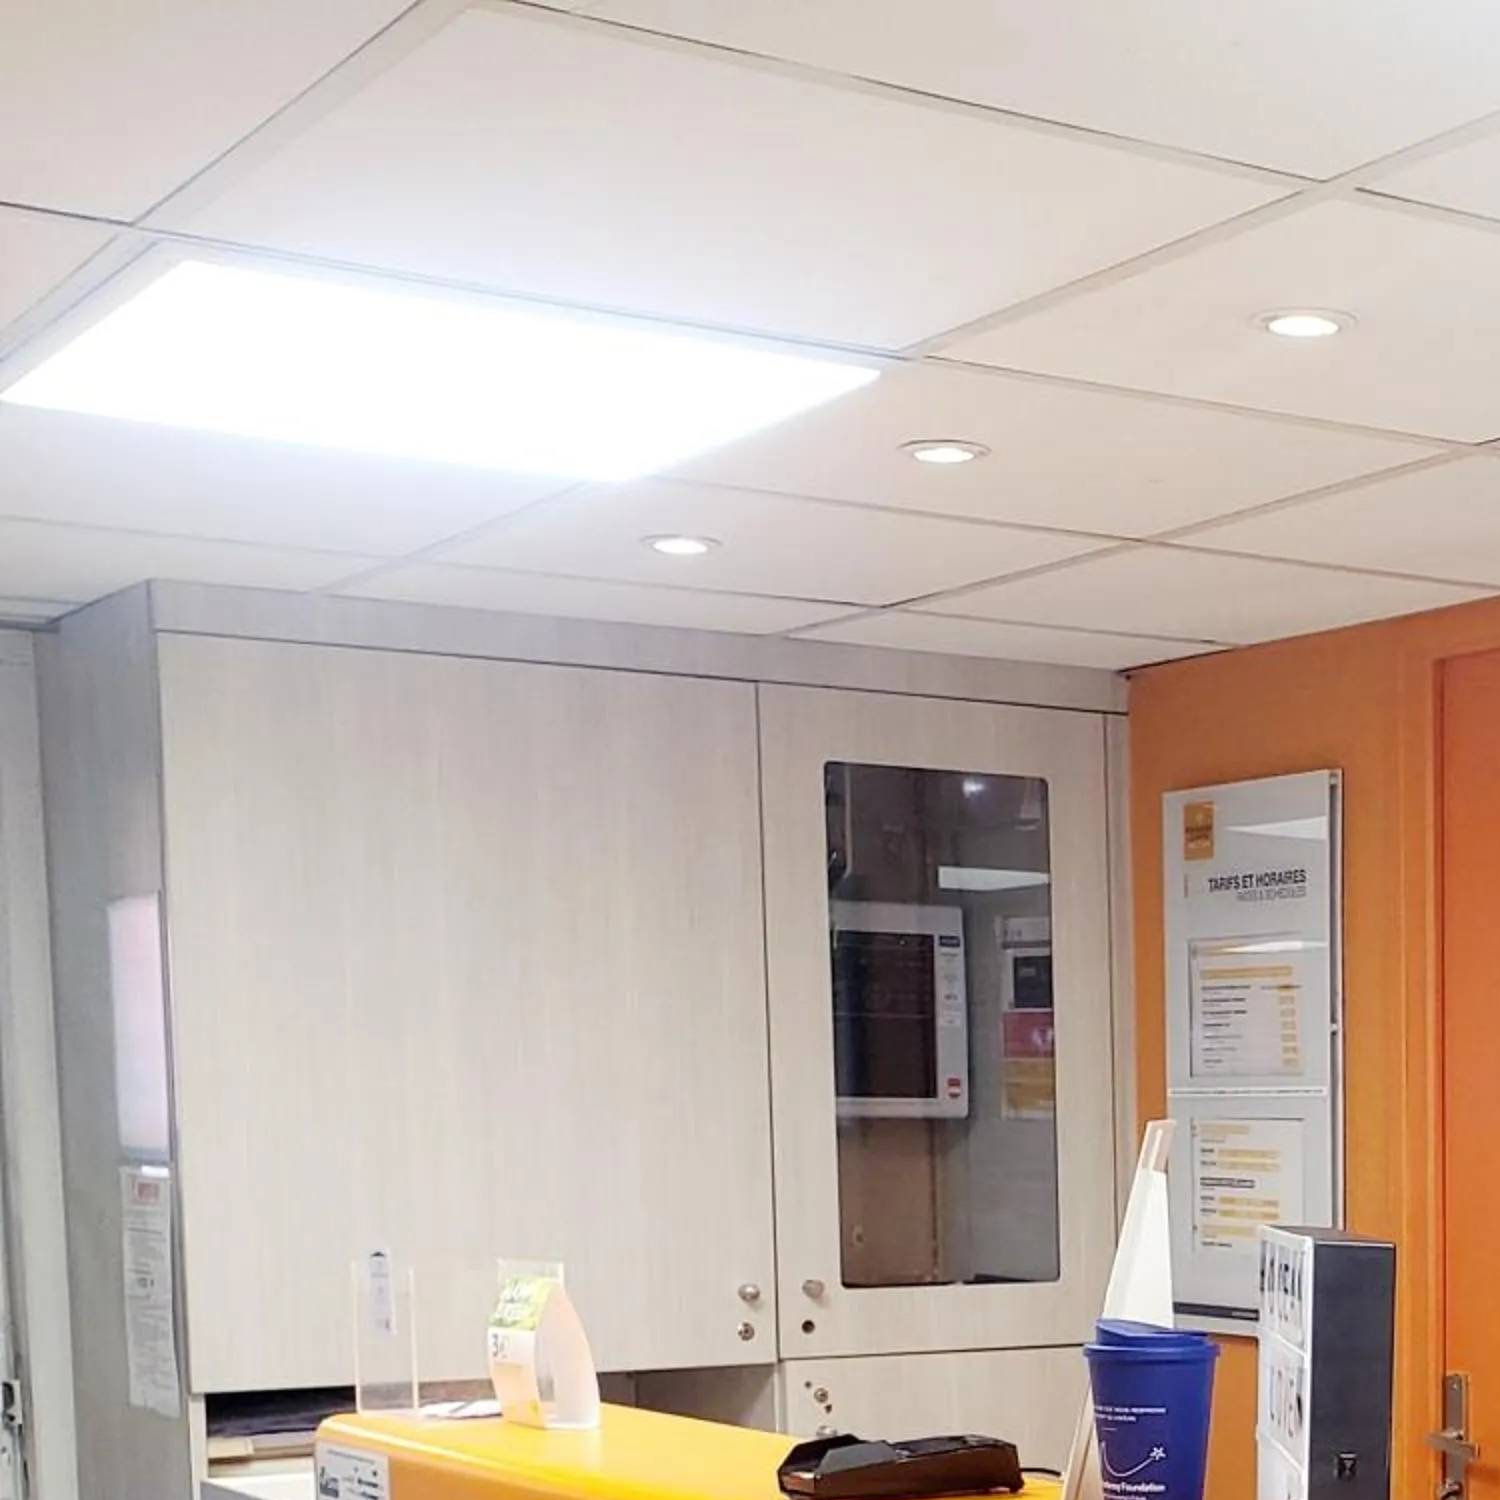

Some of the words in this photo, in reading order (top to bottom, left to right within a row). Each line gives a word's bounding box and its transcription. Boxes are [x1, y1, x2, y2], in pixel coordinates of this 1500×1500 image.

[1208, 874, 1240, 893] TARIFS
[1242, 873, 1254, 889] ET
[1255, 869, 1306, 888] HORAIRES
